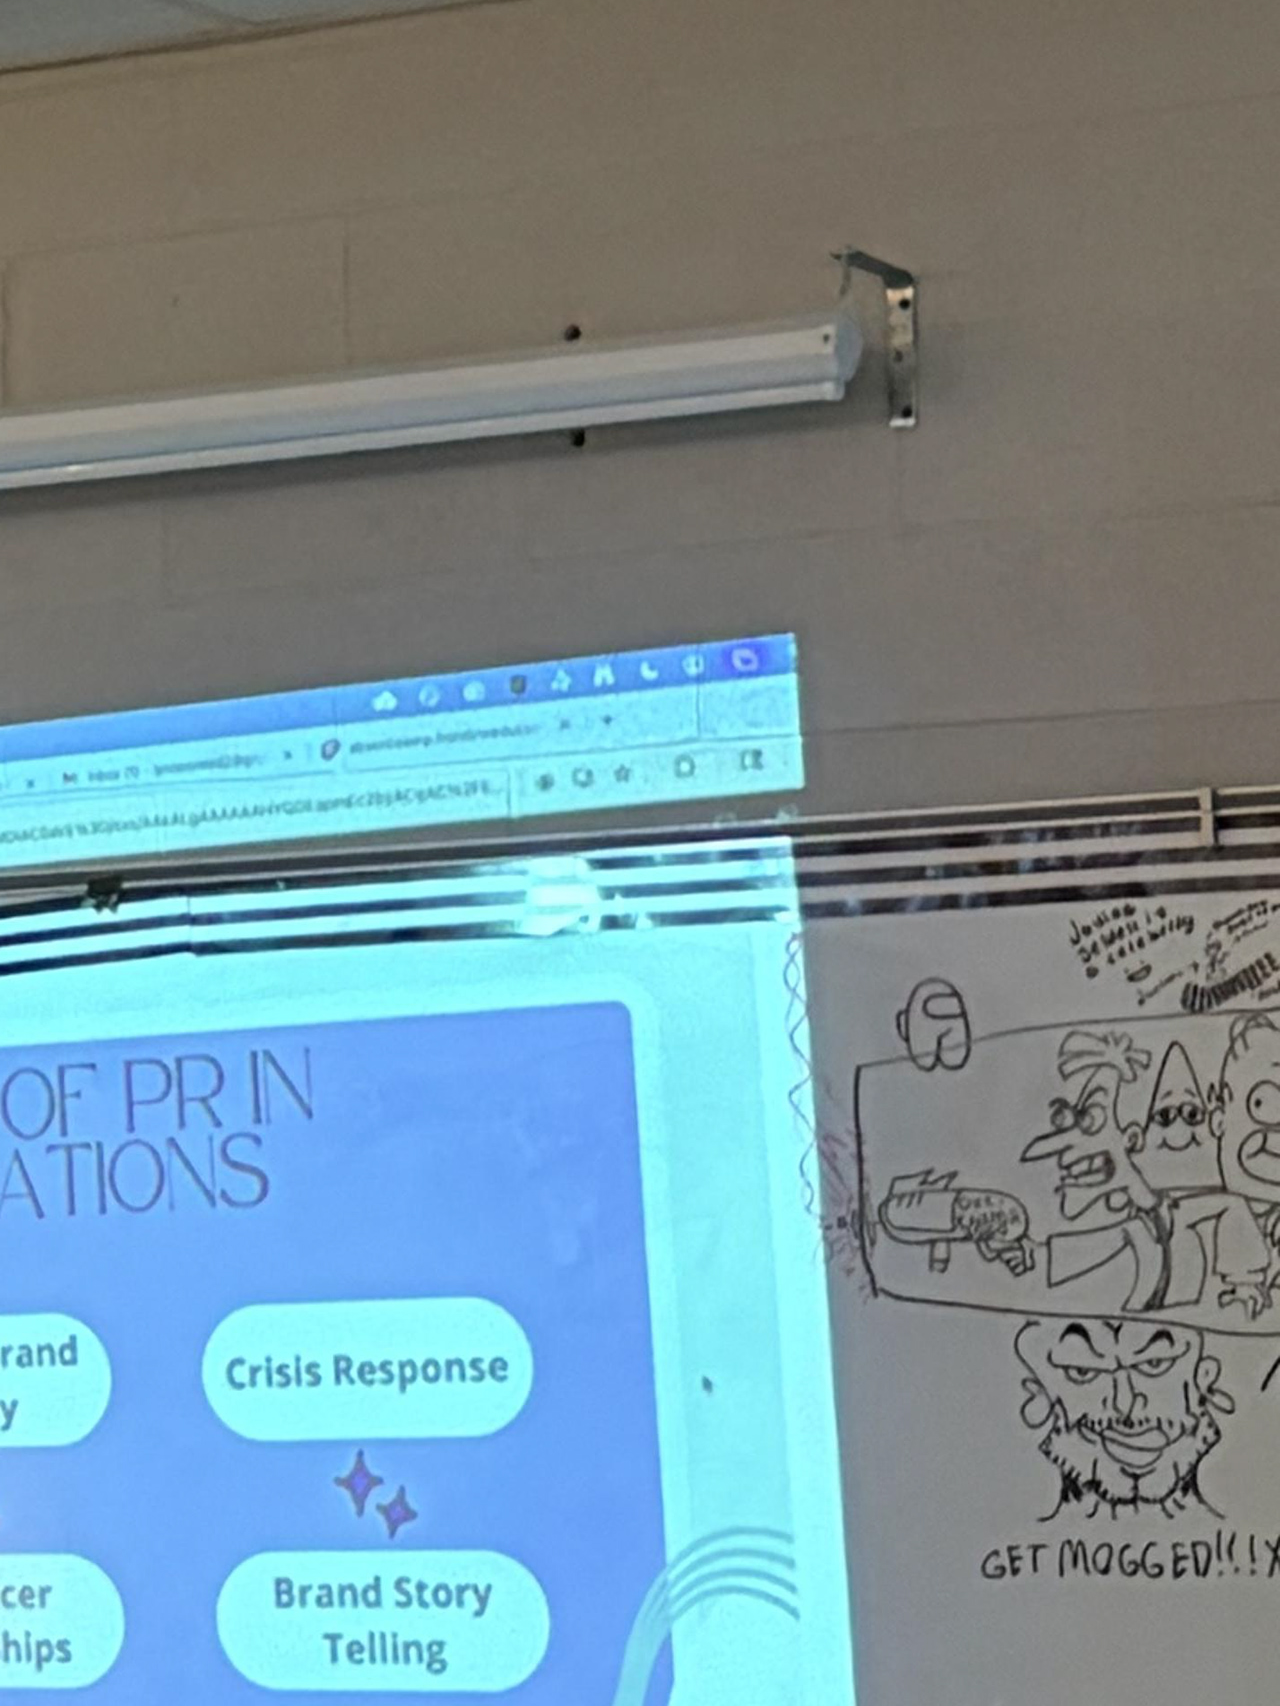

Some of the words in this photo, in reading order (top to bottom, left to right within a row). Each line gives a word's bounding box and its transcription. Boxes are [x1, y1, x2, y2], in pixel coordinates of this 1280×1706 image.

[122, 1053, 225, 1133] PR
[250, 1045, 314, 1126] IN
[225, 1355, 322, 1391] Crisis
[333, 1354, 510, 1394] Response
[980, 1543, 1049, 1580] GET
[273, 1575, 383, 1610] Brand
[394, 1575, 493, 1618] Story
[323, 1632, 449, 1675] Telling
